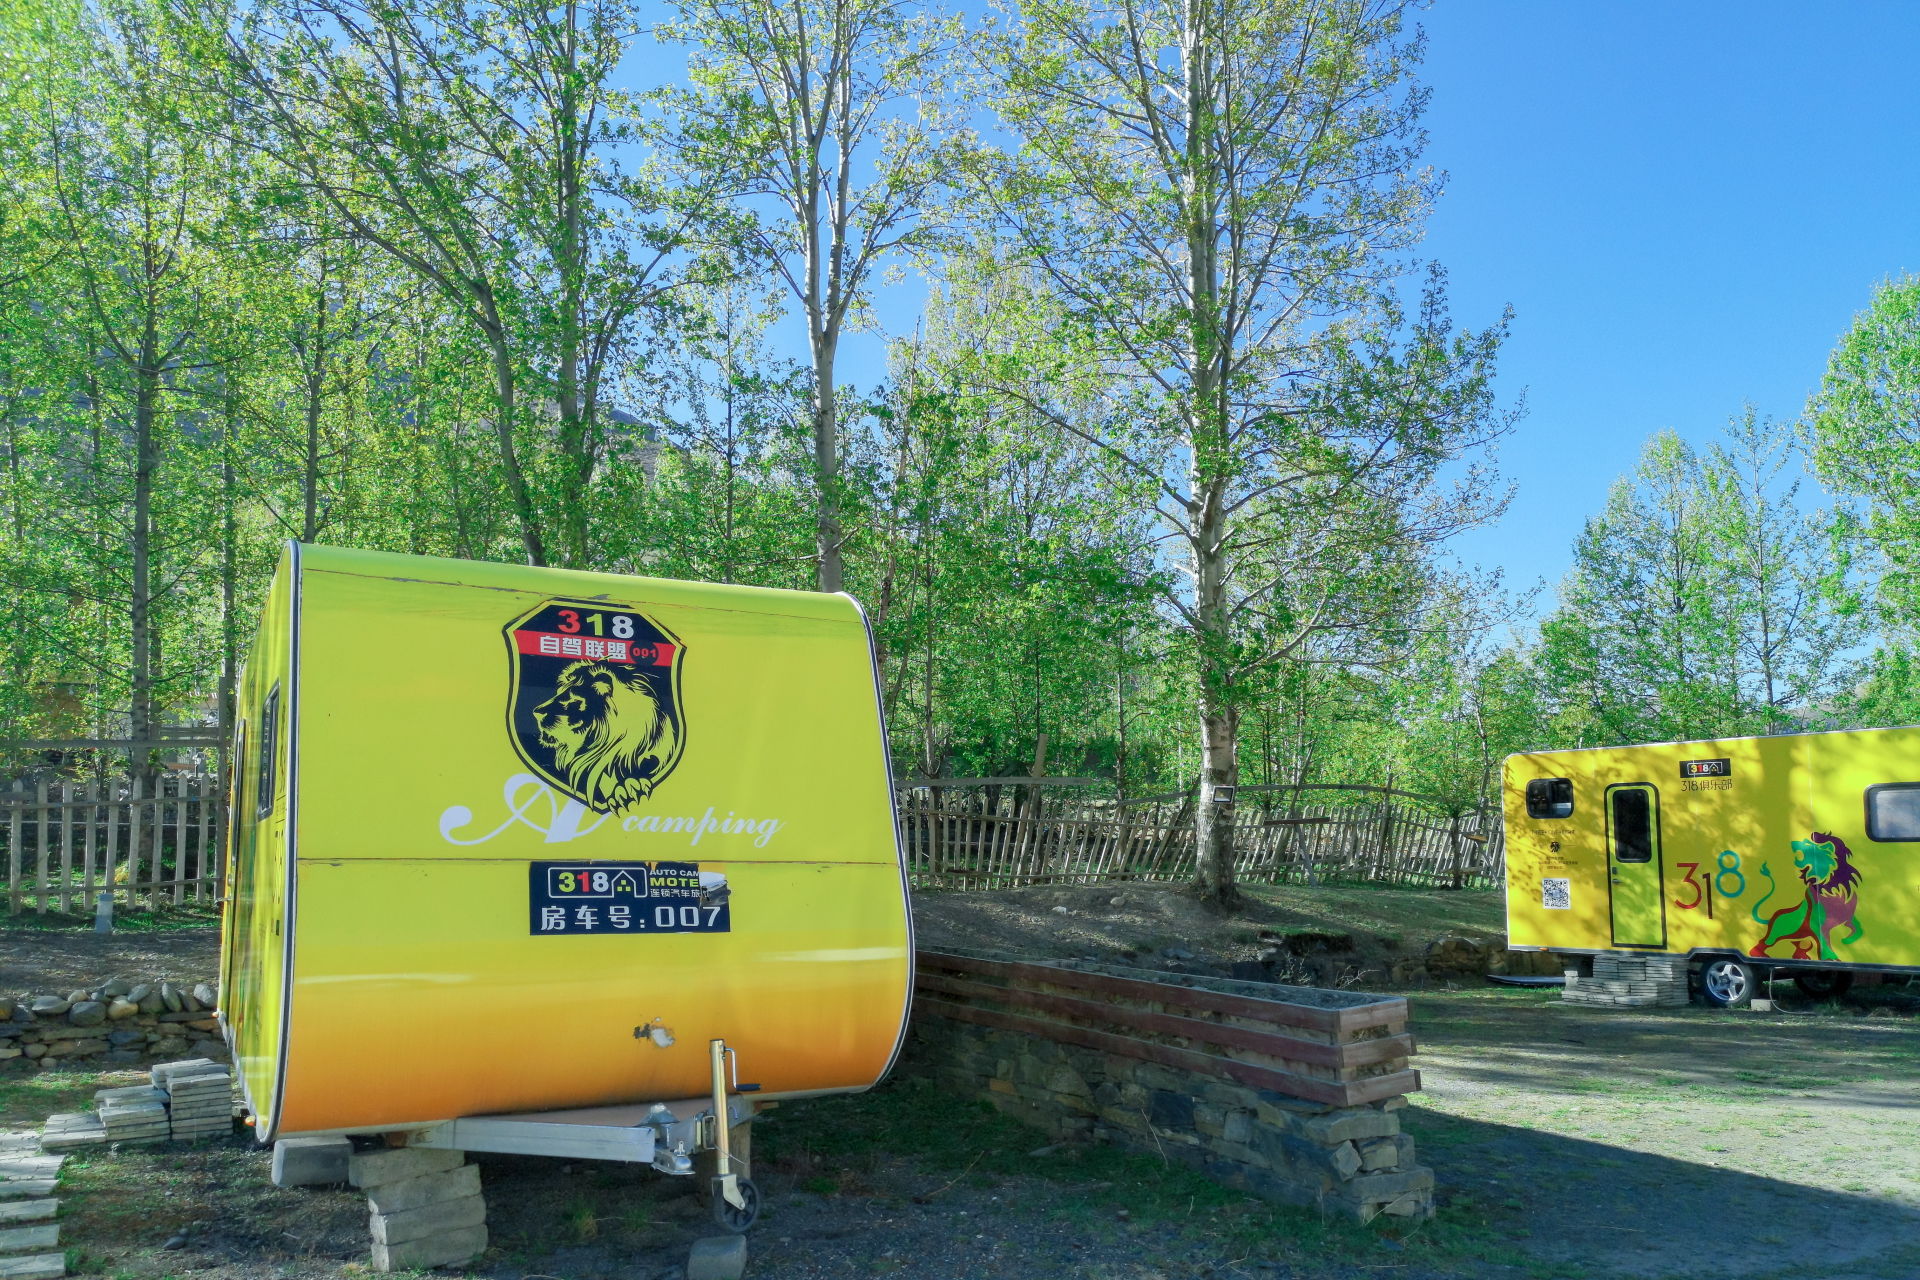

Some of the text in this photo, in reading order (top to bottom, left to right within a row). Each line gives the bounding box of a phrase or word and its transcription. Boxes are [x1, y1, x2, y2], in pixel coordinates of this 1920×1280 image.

[557, 609, 635, 639] 318
[540, 635, 627, 660] 自驾联盟
[1691, 764, 1709, 773] 318
[622, 807, 786, 848] camping
[558, 871, 609, 893] 318
[1675, 850, 1745, 919] 318
